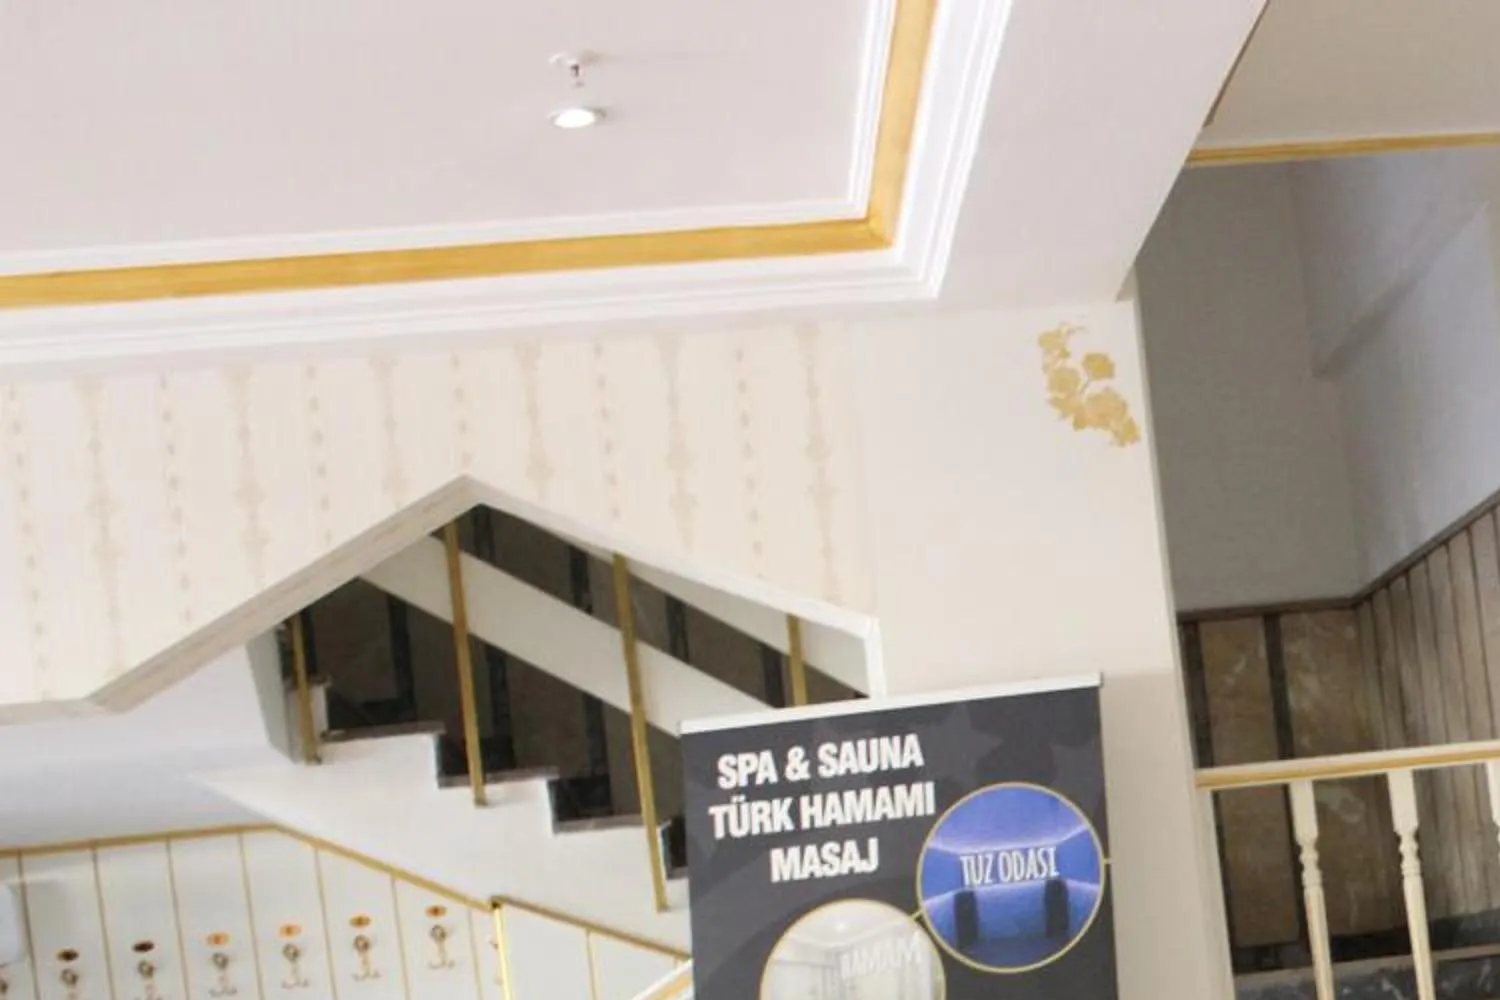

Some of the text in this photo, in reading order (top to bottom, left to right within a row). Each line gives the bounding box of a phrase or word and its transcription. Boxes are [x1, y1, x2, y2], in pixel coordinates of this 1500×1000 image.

[717, 733, 924, 789] SPA & SAUNA
[708, 782, 936, 840] TÜRK HAMAMI
[770, 837, 879, 884] MASAJ
[959, 846, 1060, 887] TUZ ODASI
